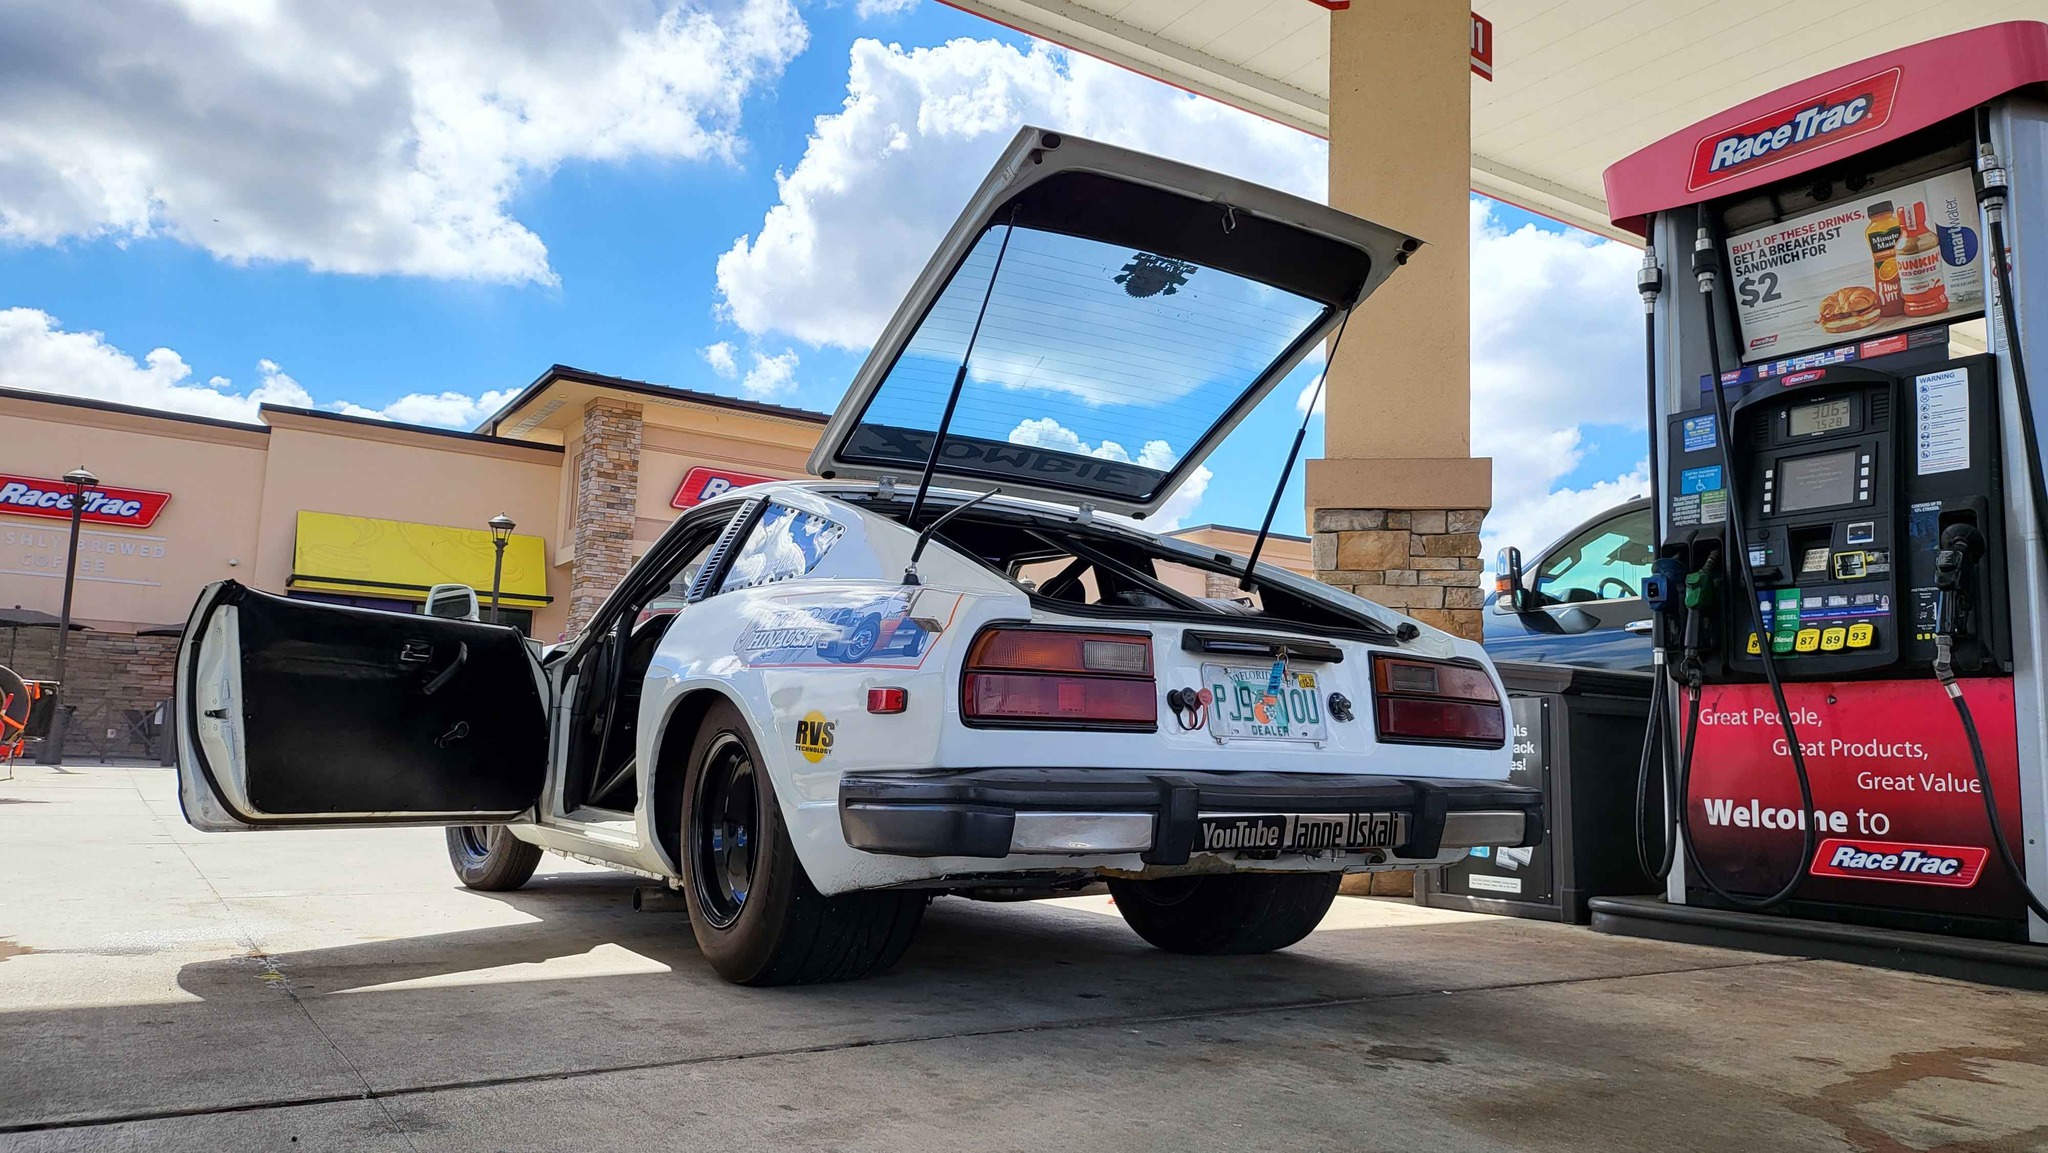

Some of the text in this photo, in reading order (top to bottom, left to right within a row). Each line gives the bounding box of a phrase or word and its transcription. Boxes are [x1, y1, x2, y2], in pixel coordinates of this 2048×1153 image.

[1709, 96, 1868, 173] RaceTrac
[1732, 210, 1865, 255] BUY 1 OF THESE DRINKS,
[1871, 232, 1899, 245] Minute
[1945, 197, 1967, 266] smartwater
[1733, 226, 1842, 266] GET A BREAKFAST
[1877, 240, 1896, 251] Maid
[1735, 243, 1827, 277] SANDWICH FOR
[1913, 264, 1937, 276] COFFEE
[1738, 271, 1782, 308] $2
[1751, 336, 1776, 347] RaceTrac
[1789, 372, 1816, 383] RaceTrac
[1919, 371, 1955, 384] WARNING
[0, 482, 141, 517] RaceTrac
[77, 538, 166, 559] BREWED
[18, 553, 105, 572] COFEE
[1773, 634, 1794, 643] Diesel
[1799, 636, 1815, 645] 87
[1825, 635, 1841, 645] 89
[1851, 632, 1867, 641] 93
[1212, 683, 1255, 721] PJ9
[1700, 708, 1749, 726] Great
[795, 718, 836, 747] RVS
[1251, 724, 1290, 737] DEALER
[795, 744, 833, 755] TECHNOLOGY
[1512, 740, 1535, 755] ack
[1773, 738, 1929, 761] Geat Products,
[1511, 757, 1527, 771] es!
[1857, 771, 1915, 791] Great
[1203, 812, 1399, 850] YouTube Janne Uskali
[1856, 807, 1890, 836] to
[1829, 846, 1960, 876] RaceTrac
